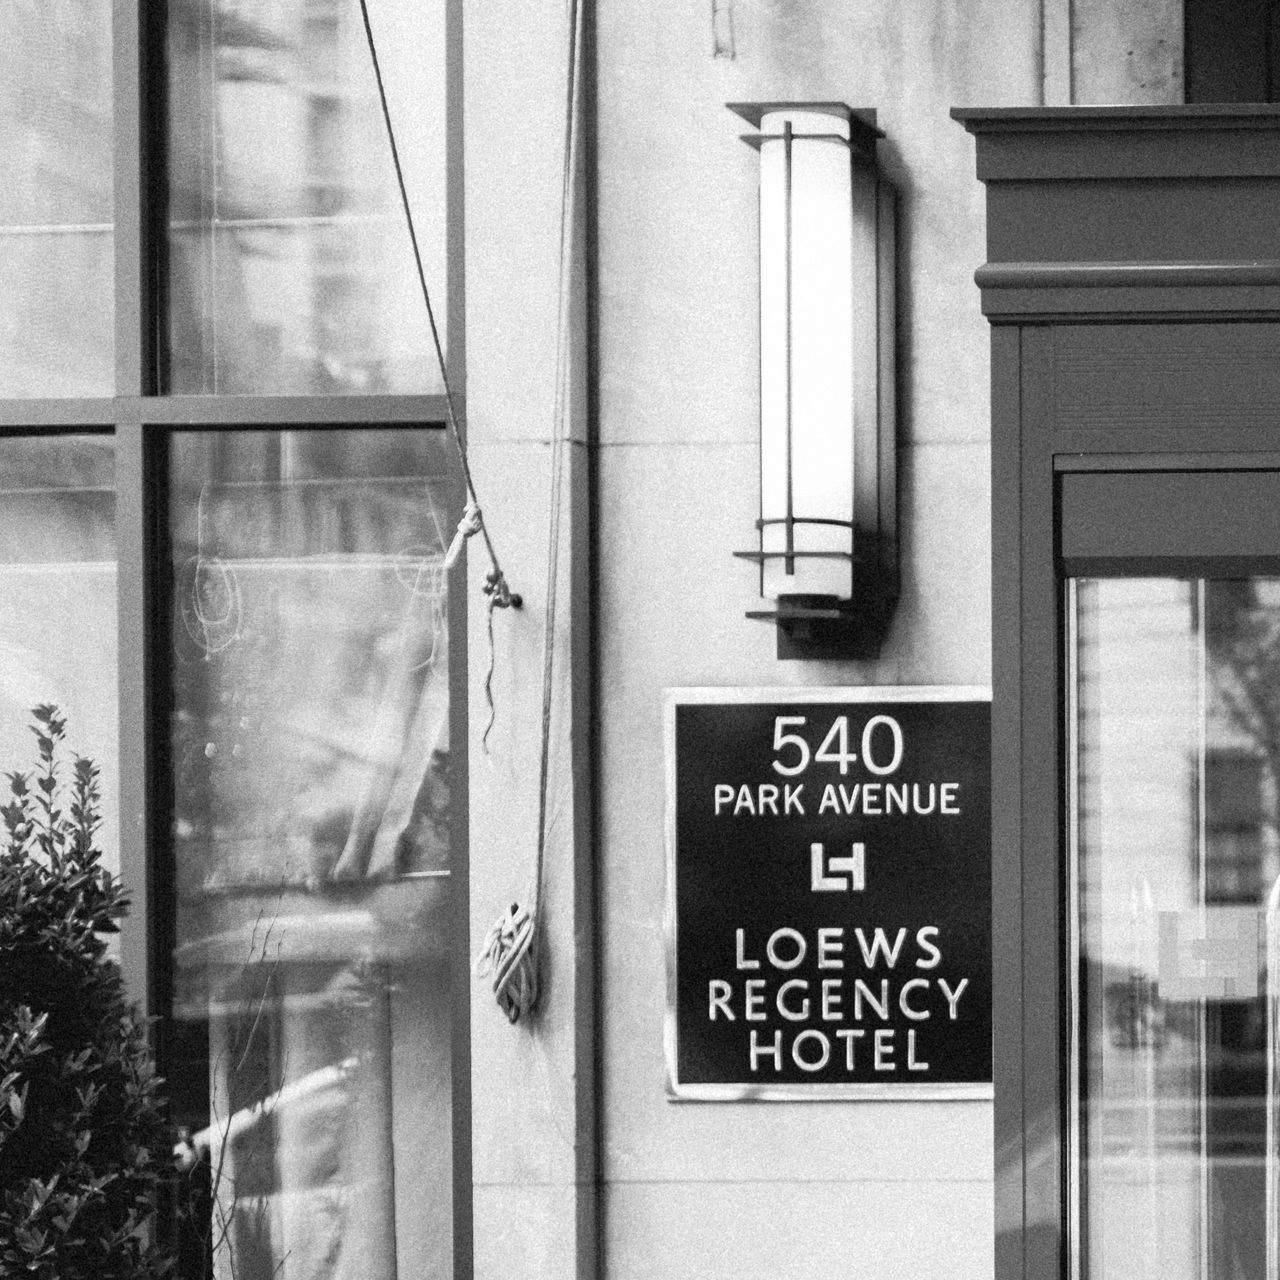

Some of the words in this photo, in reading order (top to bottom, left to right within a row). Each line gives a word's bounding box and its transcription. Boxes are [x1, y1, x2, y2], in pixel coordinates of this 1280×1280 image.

[771, 715, 904, 776] 540
[714, 784, 805, 815] PARK
[818, 783, 960, 815] AVENUE
[736, 926, 941, 969] LOEWS
[709, 978, 968, 1021] REGENCY
[750, 1029, 929, 1071] HOTEL
